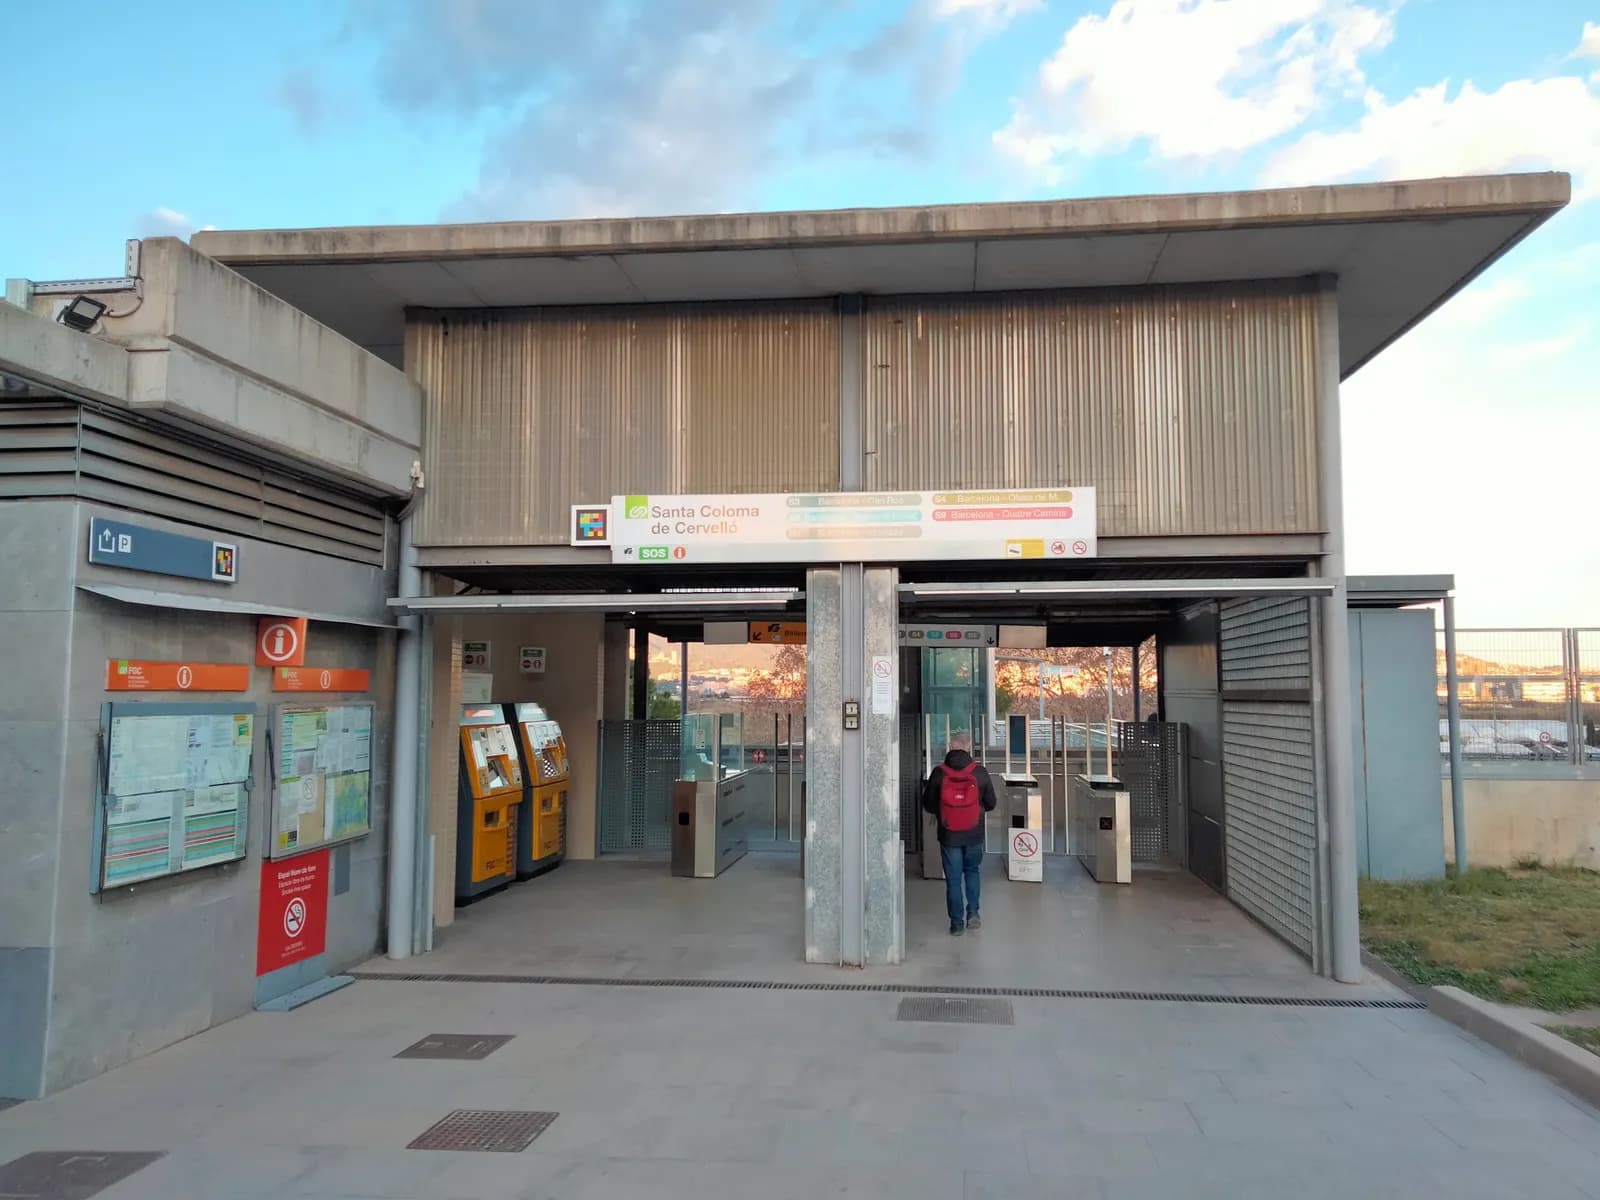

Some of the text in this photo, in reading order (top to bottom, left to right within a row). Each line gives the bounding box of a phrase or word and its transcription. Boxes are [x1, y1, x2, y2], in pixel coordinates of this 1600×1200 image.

[651, 504, 759, 519] Santa Coloma
[952, 510, 994, 519] Barcelona
[651, 521, 738, 535] de Cervelló
[642, 548, 667, 558] SOS
